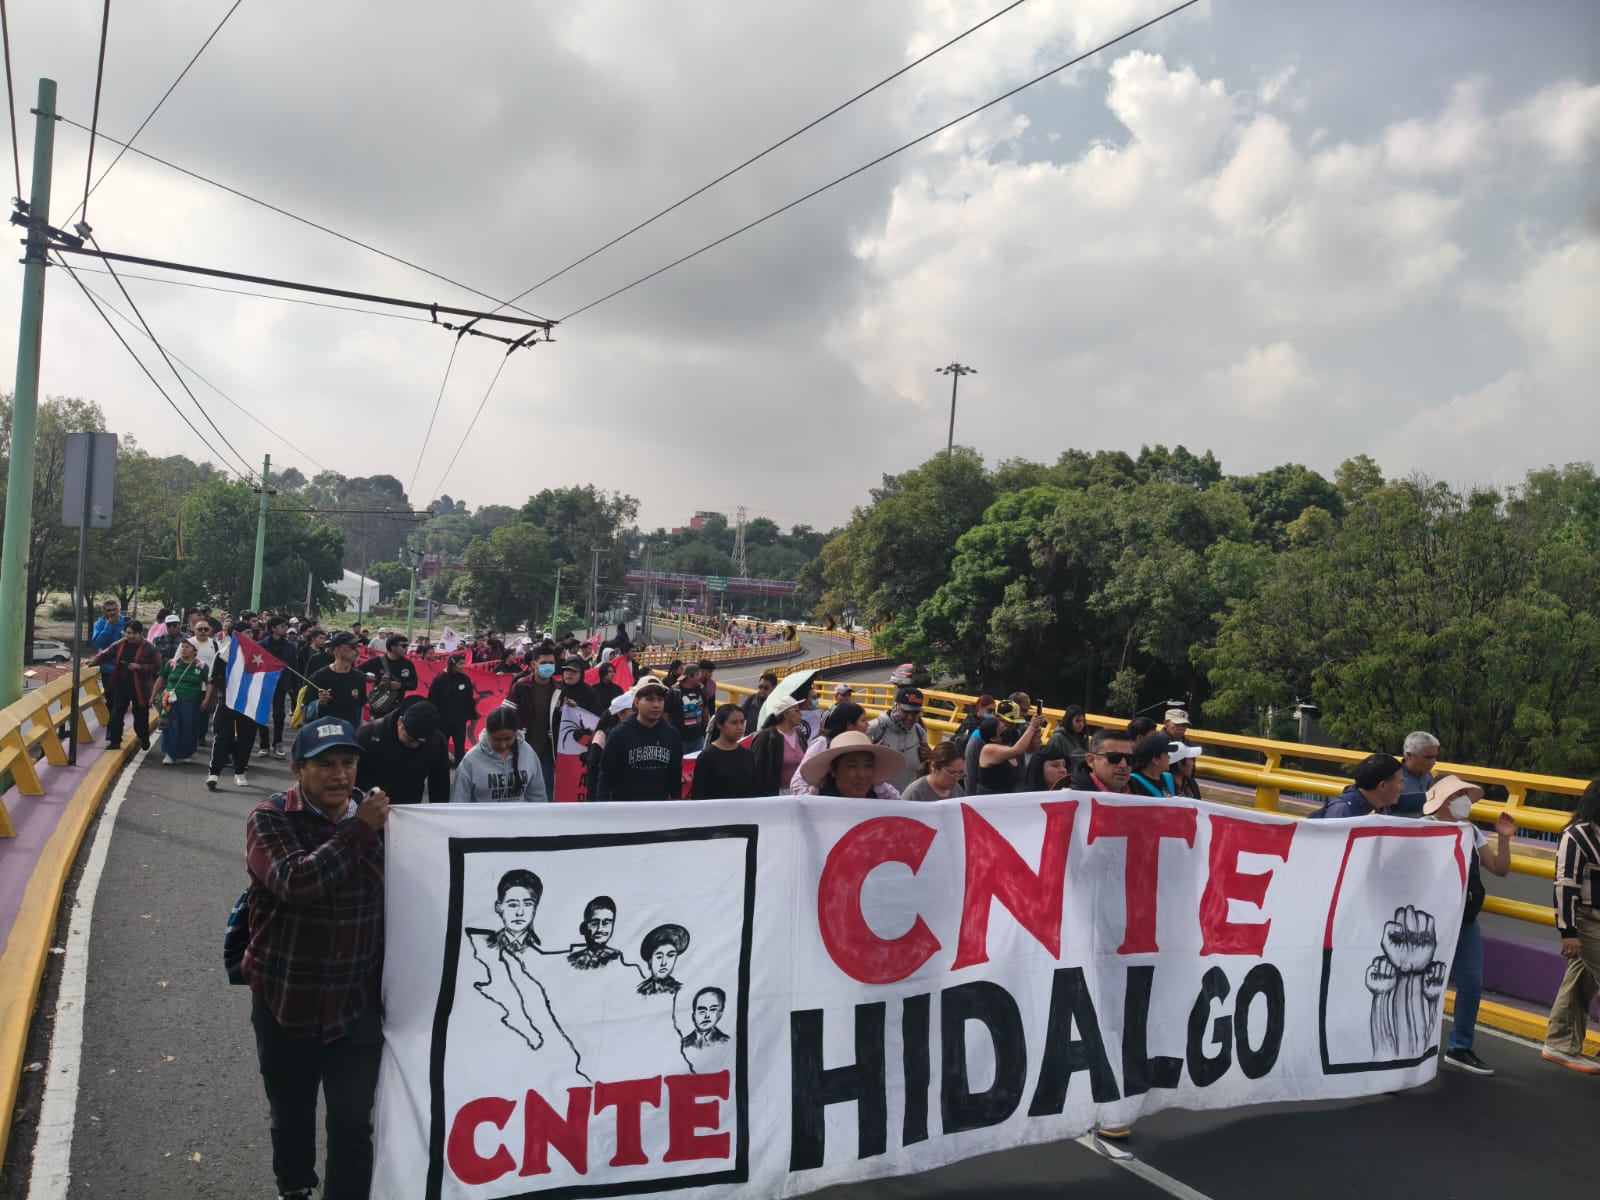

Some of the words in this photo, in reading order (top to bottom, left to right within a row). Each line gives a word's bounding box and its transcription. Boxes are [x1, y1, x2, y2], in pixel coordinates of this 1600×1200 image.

[487, 770, 528, 789] NEVR
[817, 798, 1297, 985] CNTE
[447, 1069, 730, 1185] CNTE
[789, 962, 1285, 1173] HIDALGO
